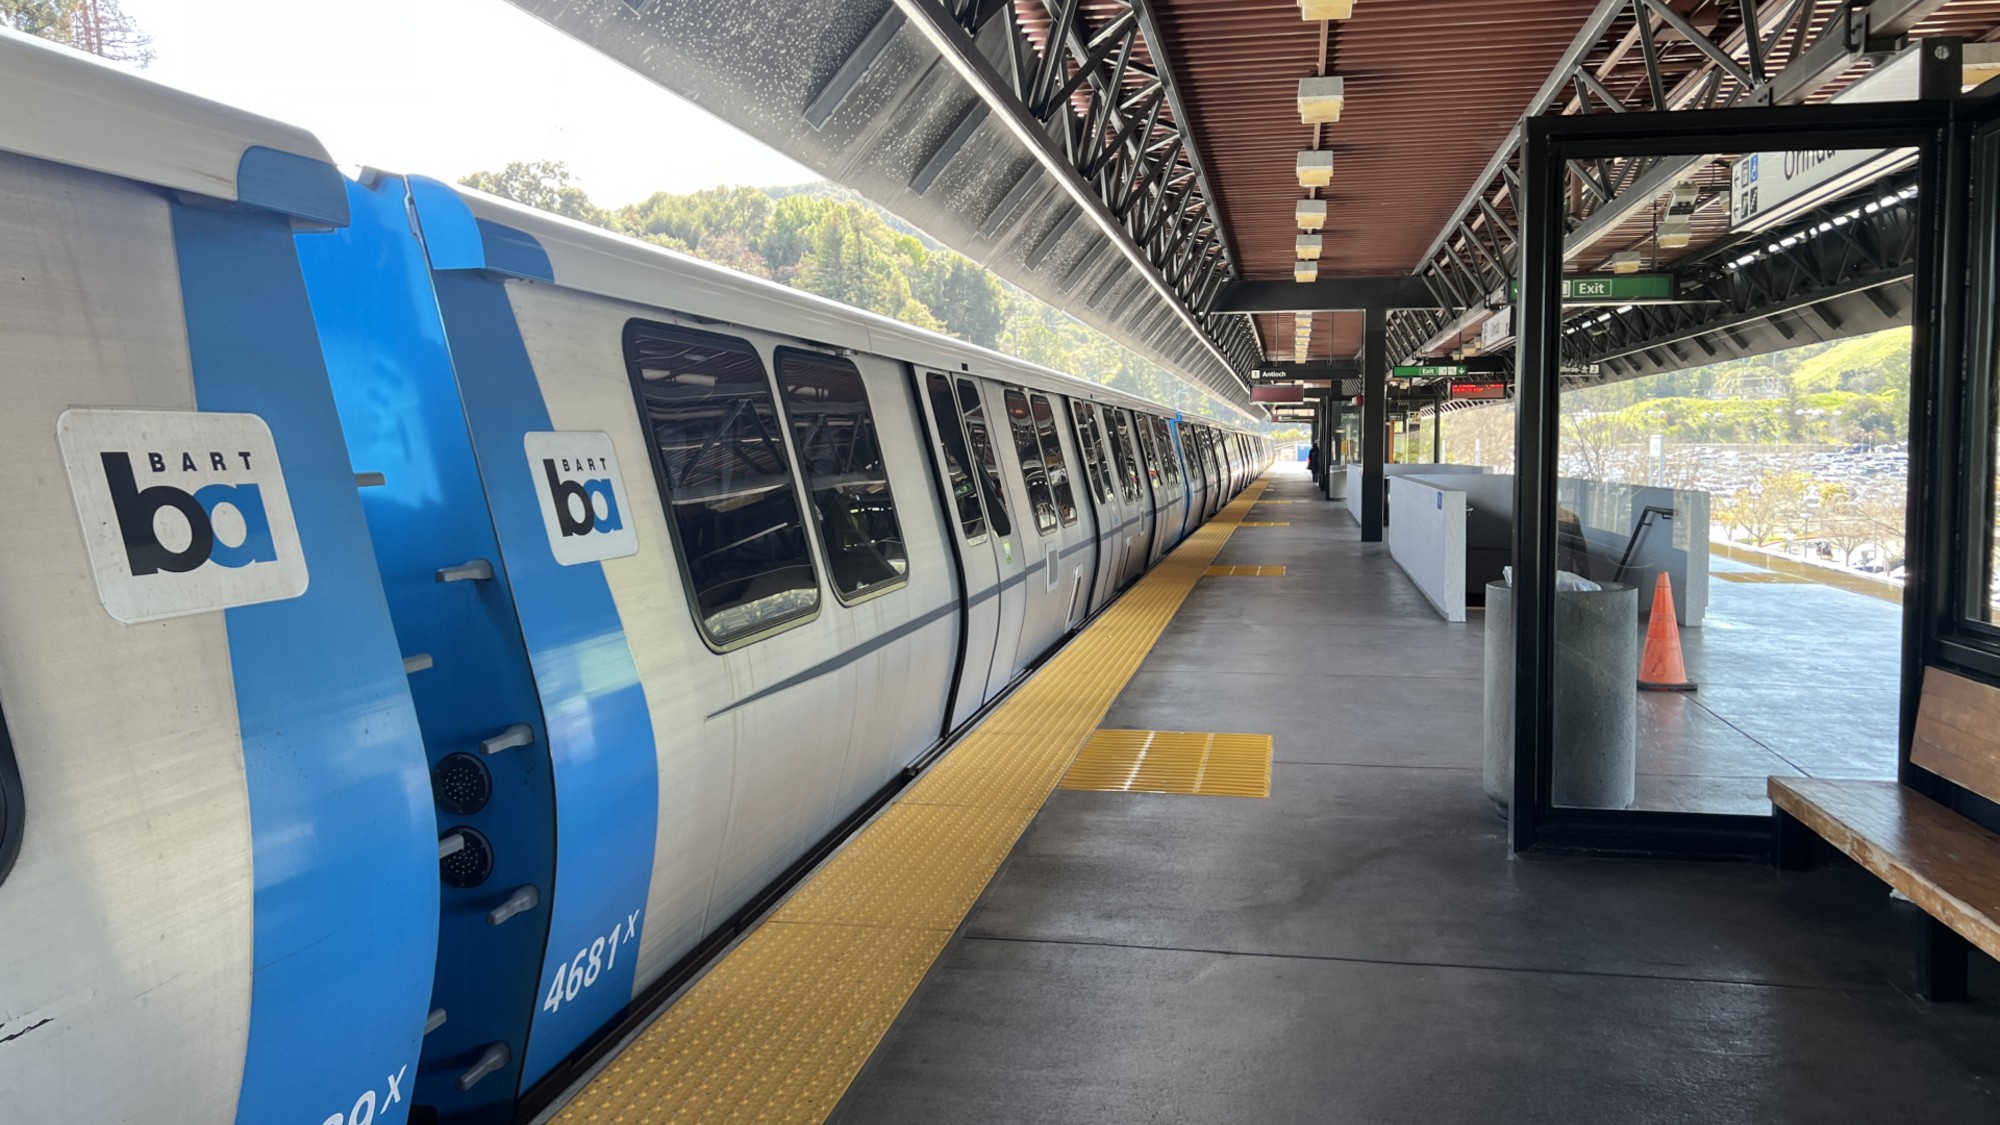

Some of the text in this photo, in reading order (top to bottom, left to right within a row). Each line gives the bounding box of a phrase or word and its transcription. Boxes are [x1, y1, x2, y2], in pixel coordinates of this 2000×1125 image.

[1579, 283, 1605, 294] Exit
[1262, 370, 1287, 378] Antioch
[148, 452, 252, 472] BART
[561, 457, 607, 472] BART
